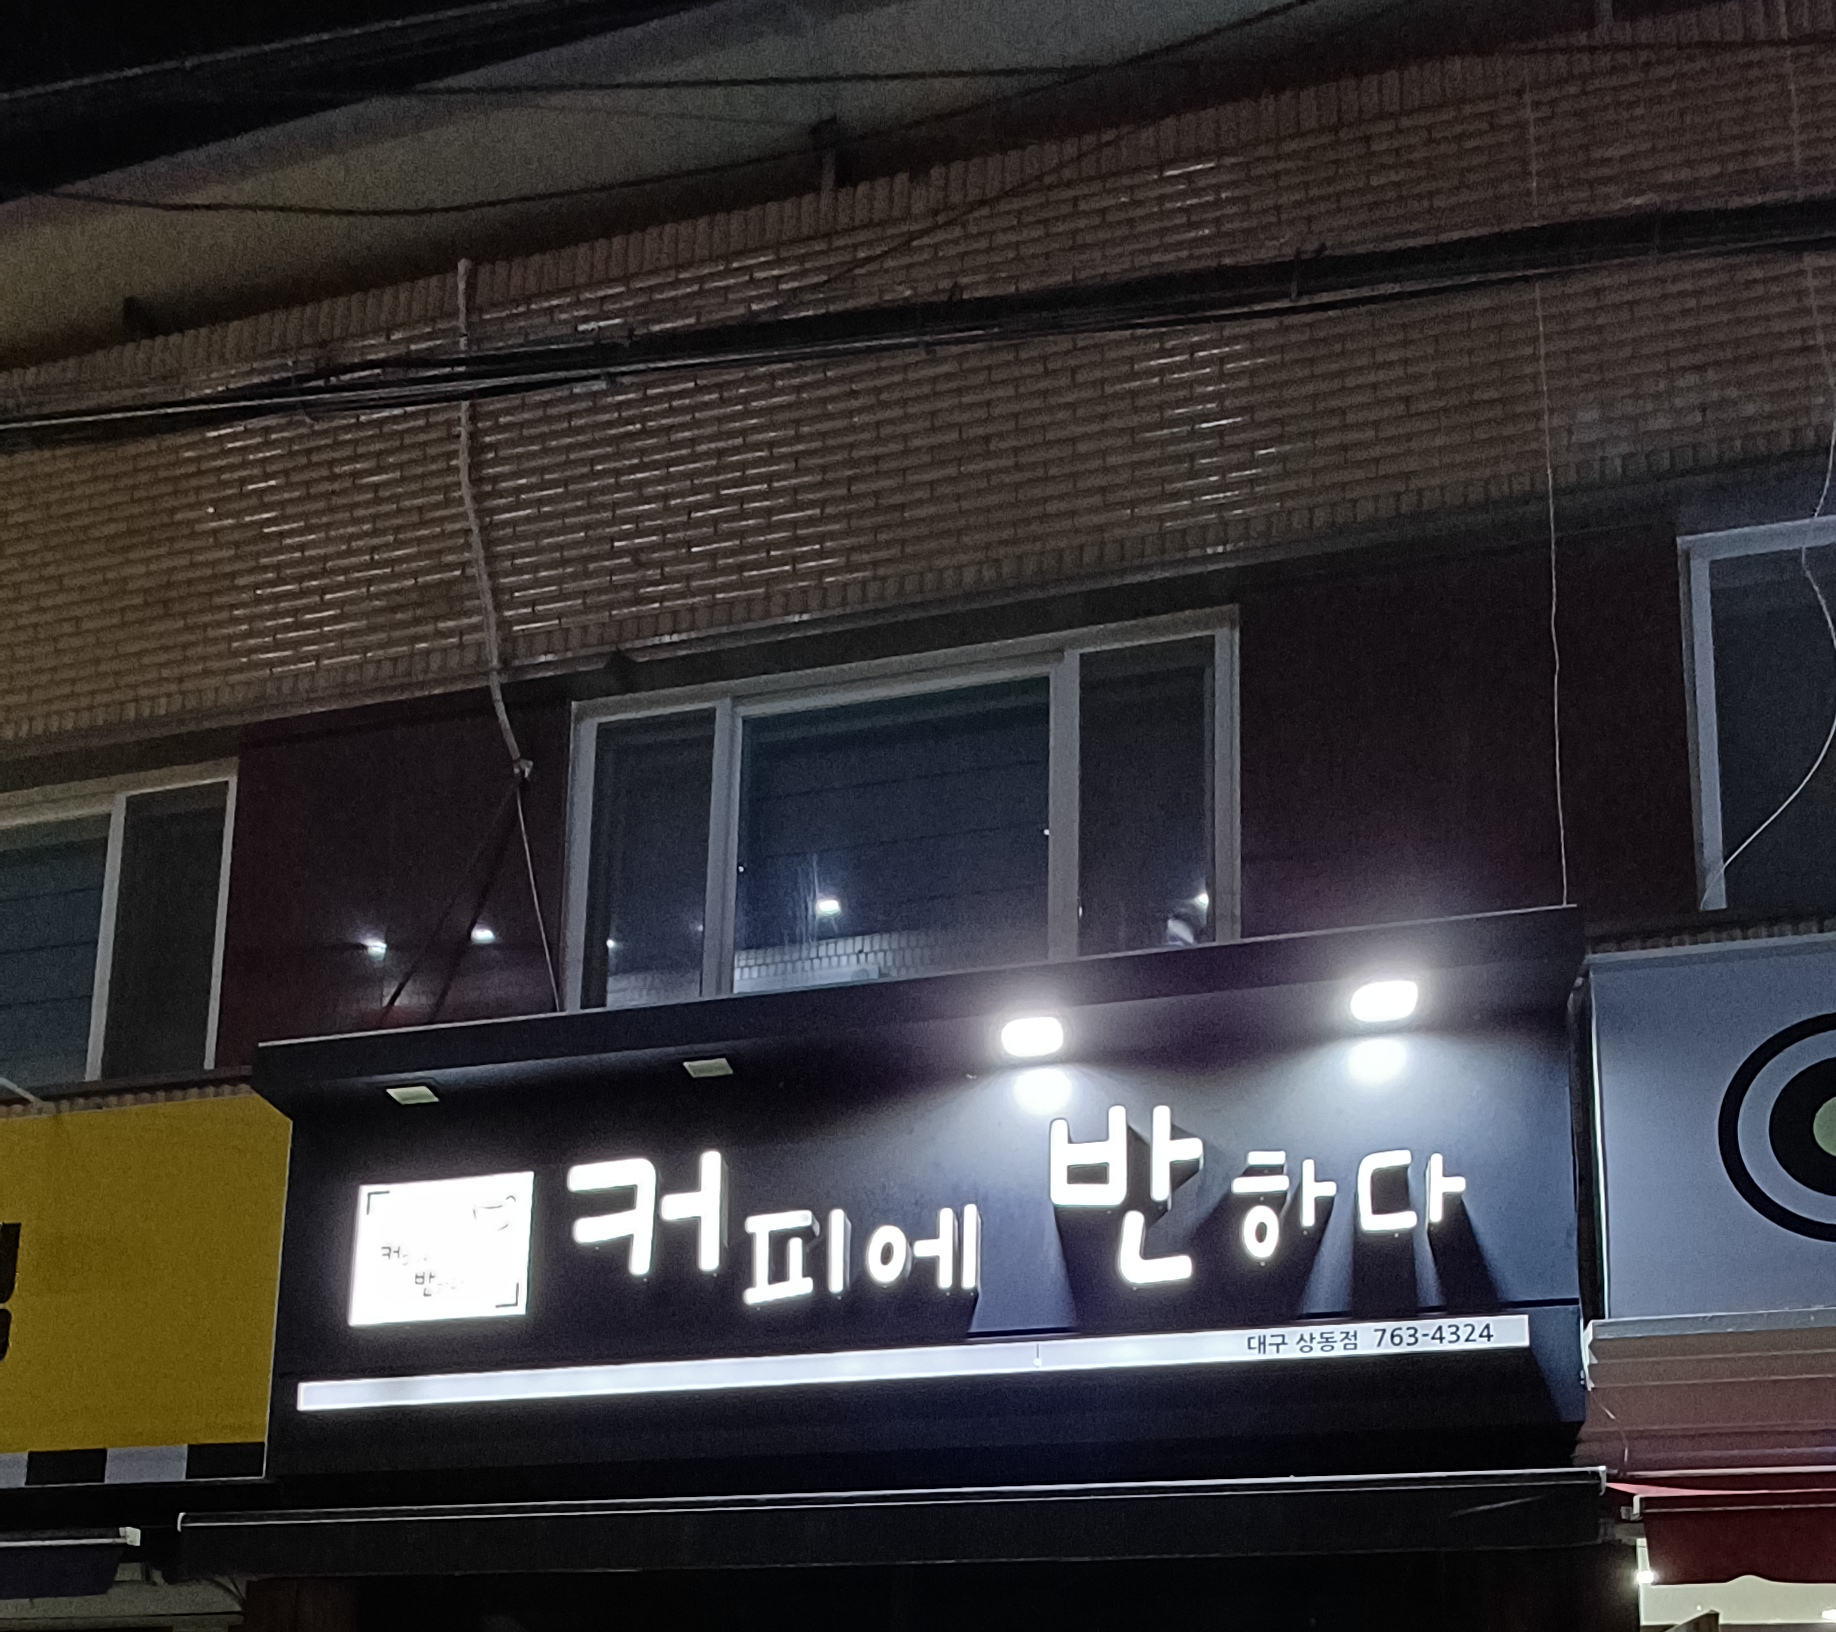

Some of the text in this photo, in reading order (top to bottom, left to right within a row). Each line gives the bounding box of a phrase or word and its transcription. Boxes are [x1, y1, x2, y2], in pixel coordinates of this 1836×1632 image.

[567, 1104, 1467, 1306] 커피에 반하다
[1246, 1322, 1494, 1354] 대구 상동점 763-4324
